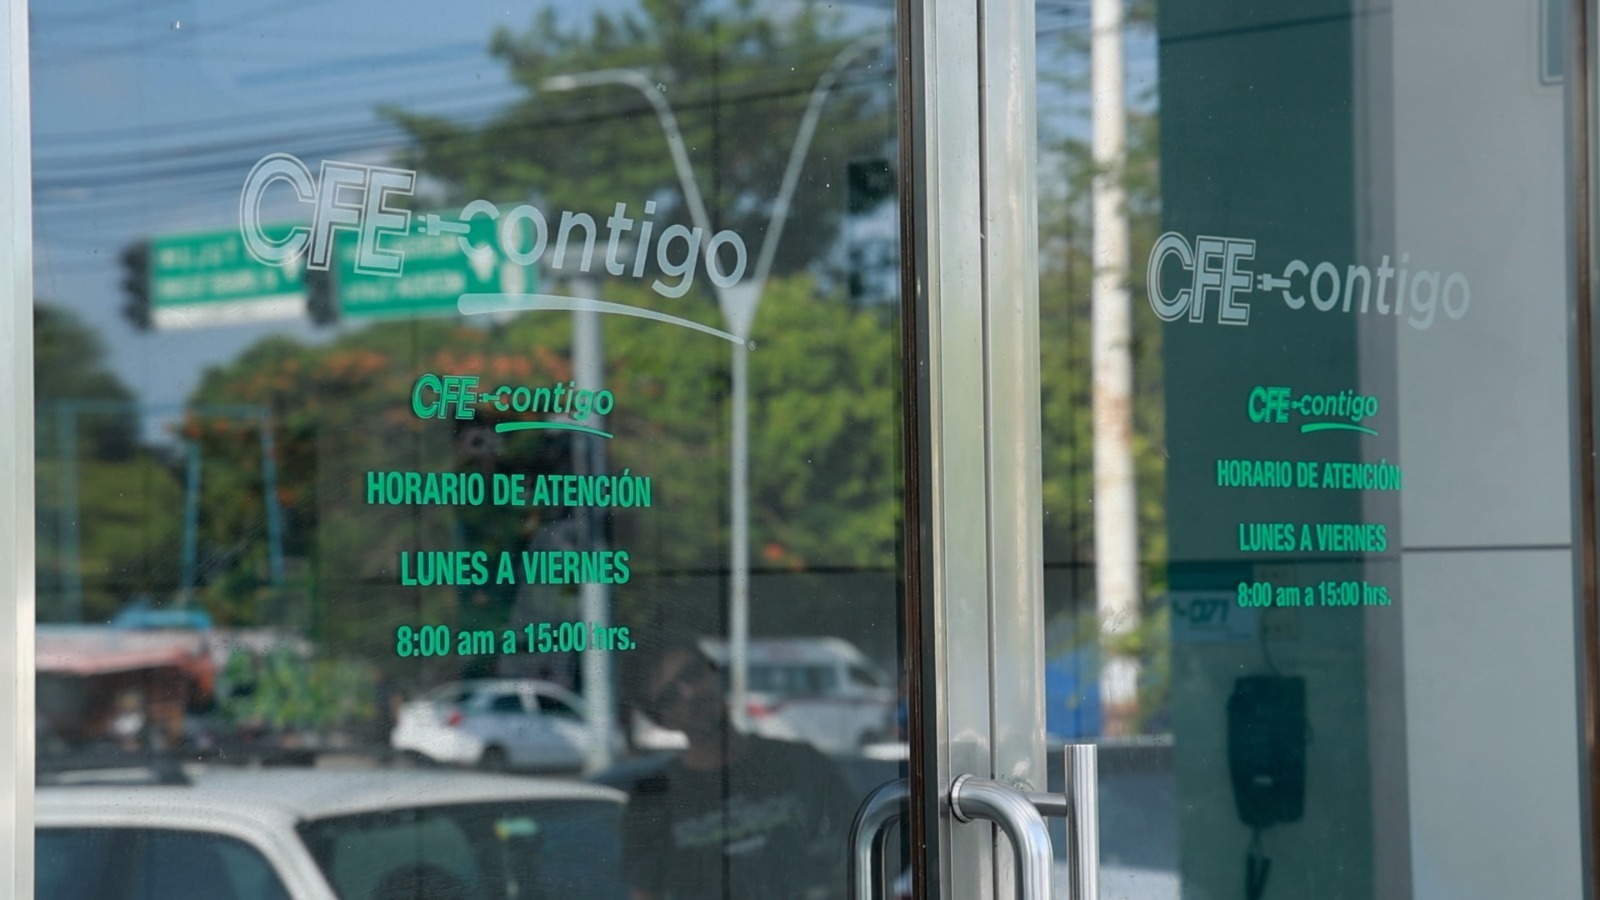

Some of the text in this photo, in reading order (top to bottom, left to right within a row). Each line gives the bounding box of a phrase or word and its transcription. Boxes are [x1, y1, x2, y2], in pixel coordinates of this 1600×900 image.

[239, 152, 747, 298] CFE contigo
[1147, 231, 1471, 330] CFE contigo
[412, 373, 614, 421] CFE contigo
[1248, 386, 1379, 424] CFE contigo
[366, 468, 651, 508] HORARIO DE ATENCIÓN
[1216, 459, 1293, 488] HORARIO
[1297, 462, 1318, 488] DE
[1239, 523, 1388, 552] LUNES A VIERNES
[401, 550, 630, 586] LUNES A VIERNES
[1237, 581, 1392, 608] 8:00 am a 15:00 hrs.
[397, 621, 636, 657] 8:00 am a 15:00 hrs.
